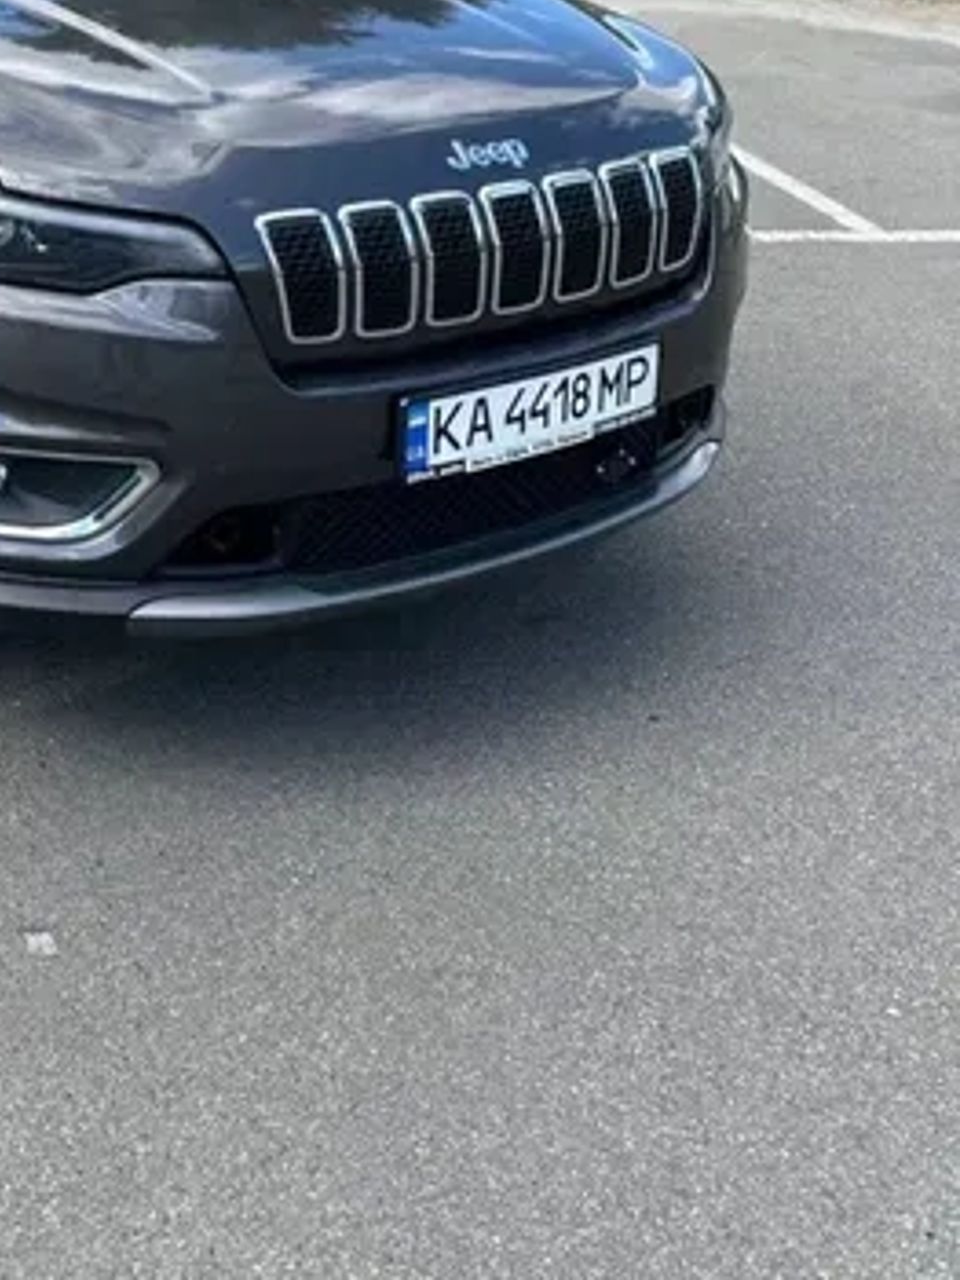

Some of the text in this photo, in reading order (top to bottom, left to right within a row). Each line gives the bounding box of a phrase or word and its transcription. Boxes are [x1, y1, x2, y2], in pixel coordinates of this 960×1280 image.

[446, 139, 529, 169] Jeep
[433, 397, 494, 454] KA
[505, 372, 590, 435] 4418
[597, 357, 649, 412] MP
